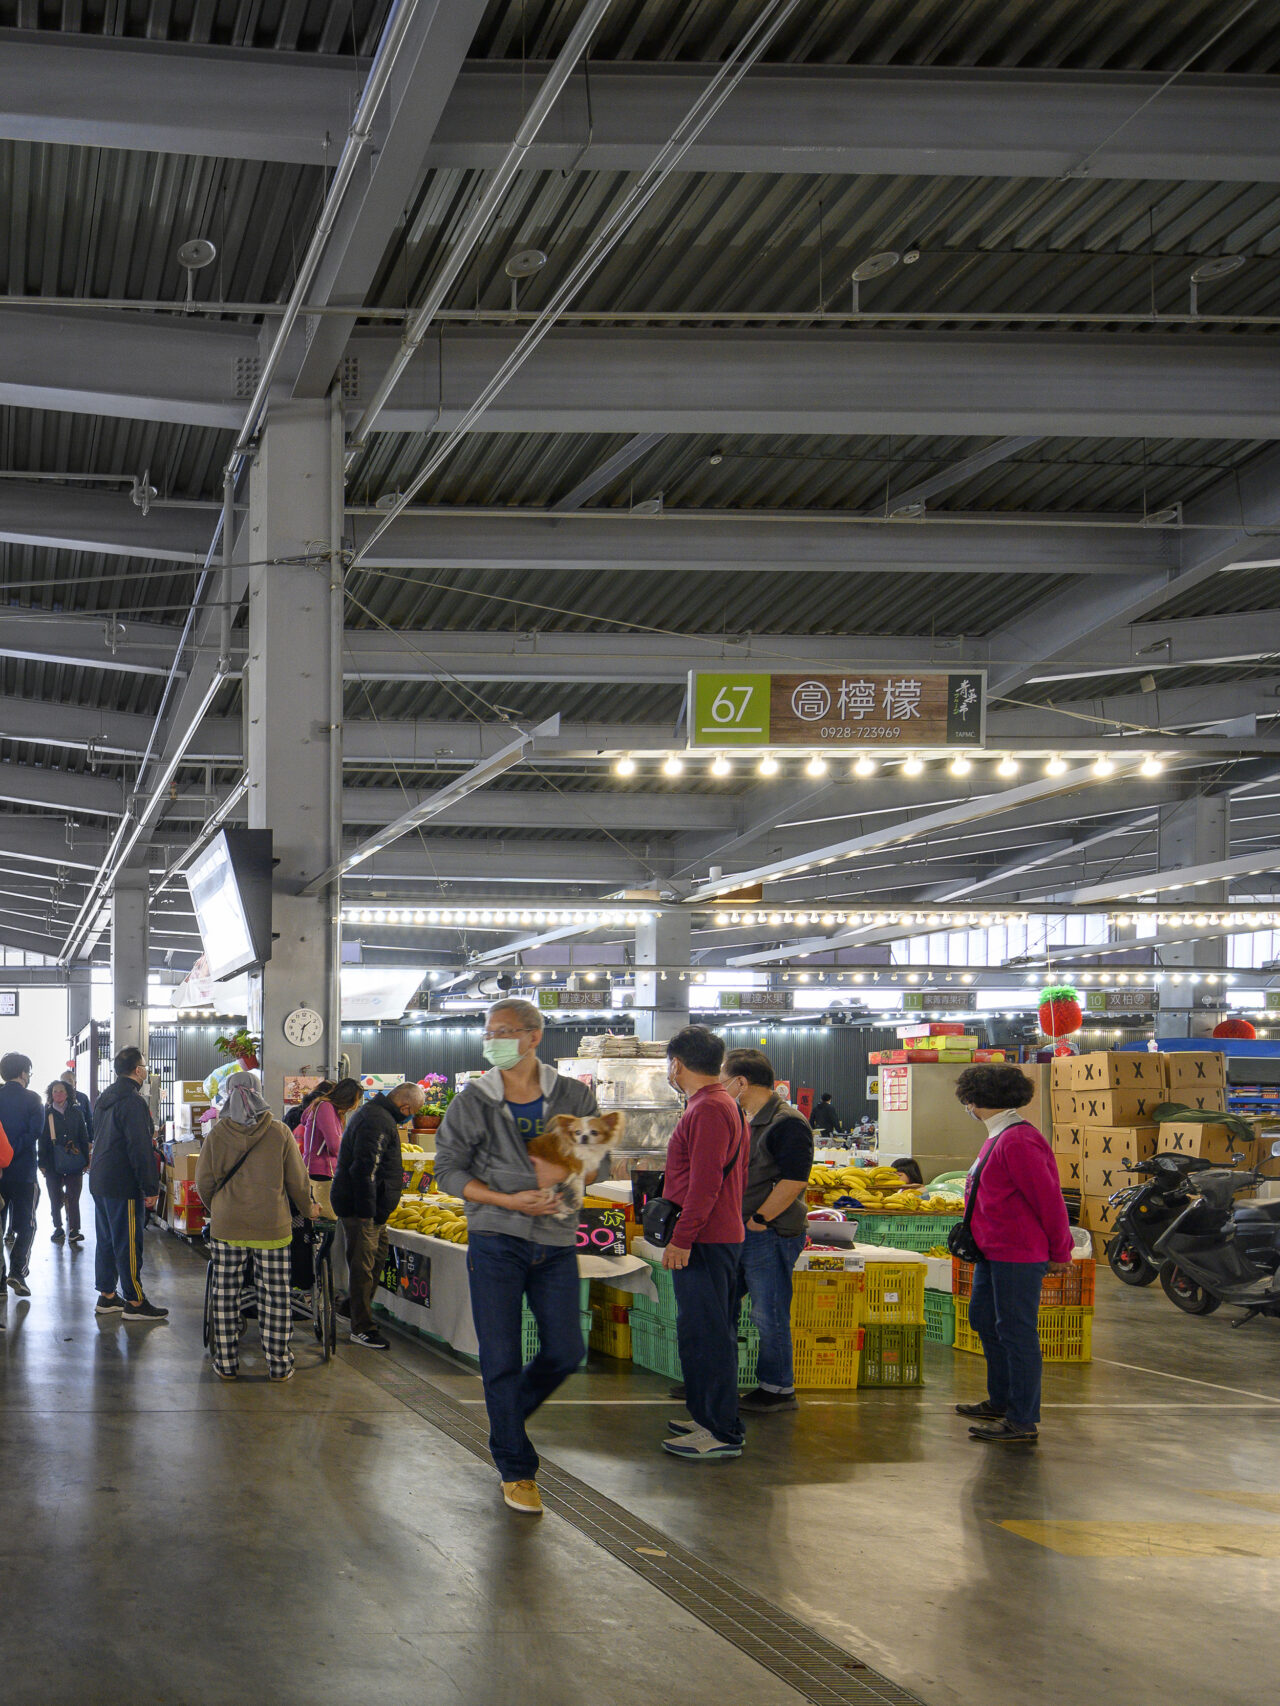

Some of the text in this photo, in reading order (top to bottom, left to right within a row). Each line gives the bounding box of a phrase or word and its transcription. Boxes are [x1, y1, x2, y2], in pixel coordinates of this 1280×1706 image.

[711, 686, 754, 722] 67
[820, 727, 901, 739] 0928-723969
[542, 994, 554, 1004] 13
[724, 994, 735, 1005] 12
[907, 995, 917, 1005] 11
[1090, 995, 1102, 1006] 10
[576, 1224, 615, 1247] 50
[411, 1276, 428, 1297] 50
